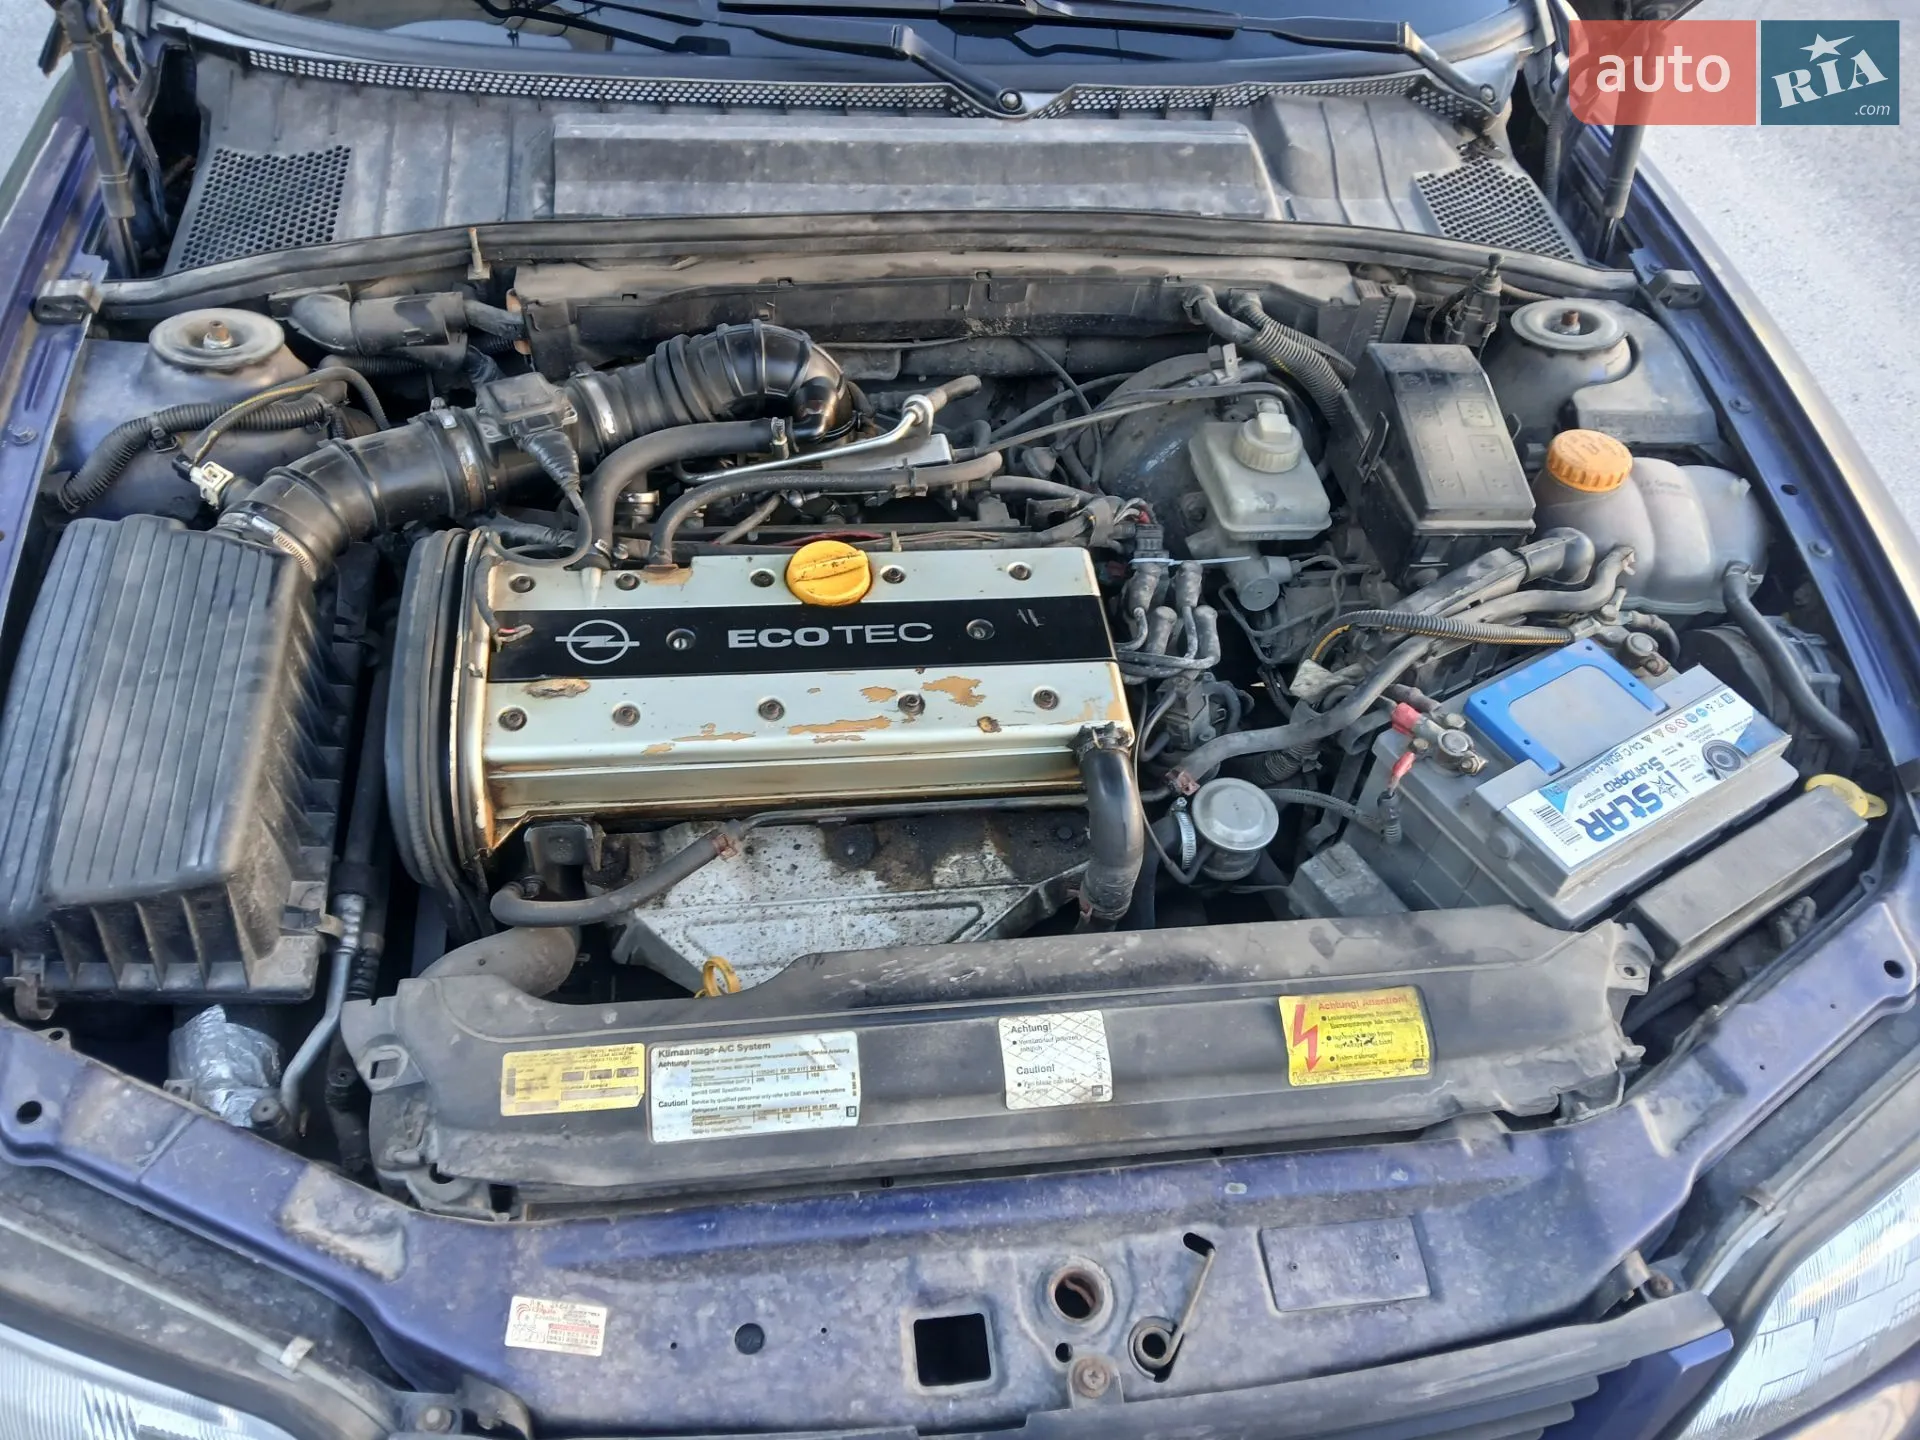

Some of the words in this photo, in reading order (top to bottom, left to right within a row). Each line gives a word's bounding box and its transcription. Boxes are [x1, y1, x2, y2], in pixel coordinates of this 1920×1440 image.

[727, 622, 934, 649] ECOTEC
[1319, 999, 1359, 1011] Achtung!
[1010, 1022, 1052, 1034] Achtung!
[736, 1042, 771, 1053] System
[658, 1059, 690, 1068] Achtung!
[1016, 1063, 1055, 1075] Caution!
[658, 1099, 688, 1108] Caution!
